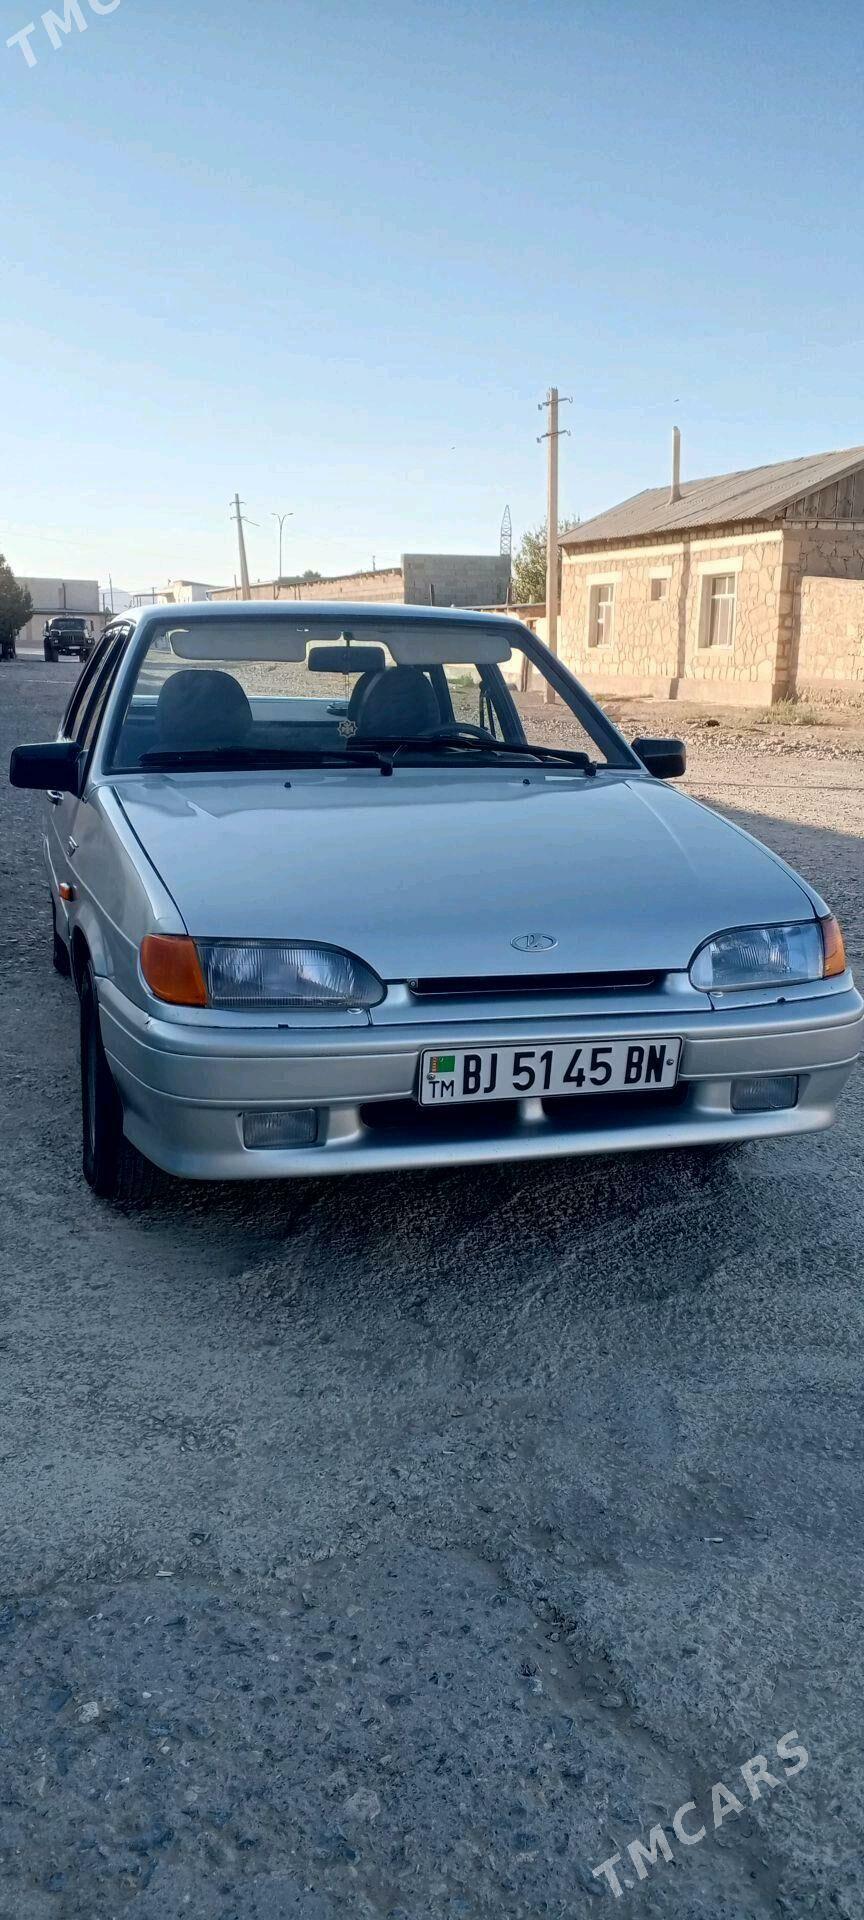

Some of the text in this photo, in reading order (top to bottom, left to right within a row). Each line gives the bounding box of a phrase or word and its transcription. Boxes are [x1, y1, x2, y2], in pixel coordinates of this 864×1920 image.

[463, 1053, 498, 1095] BJ
[624, 1045, 667, 1084] BN
[428, 1080, 454, 1098] TM
